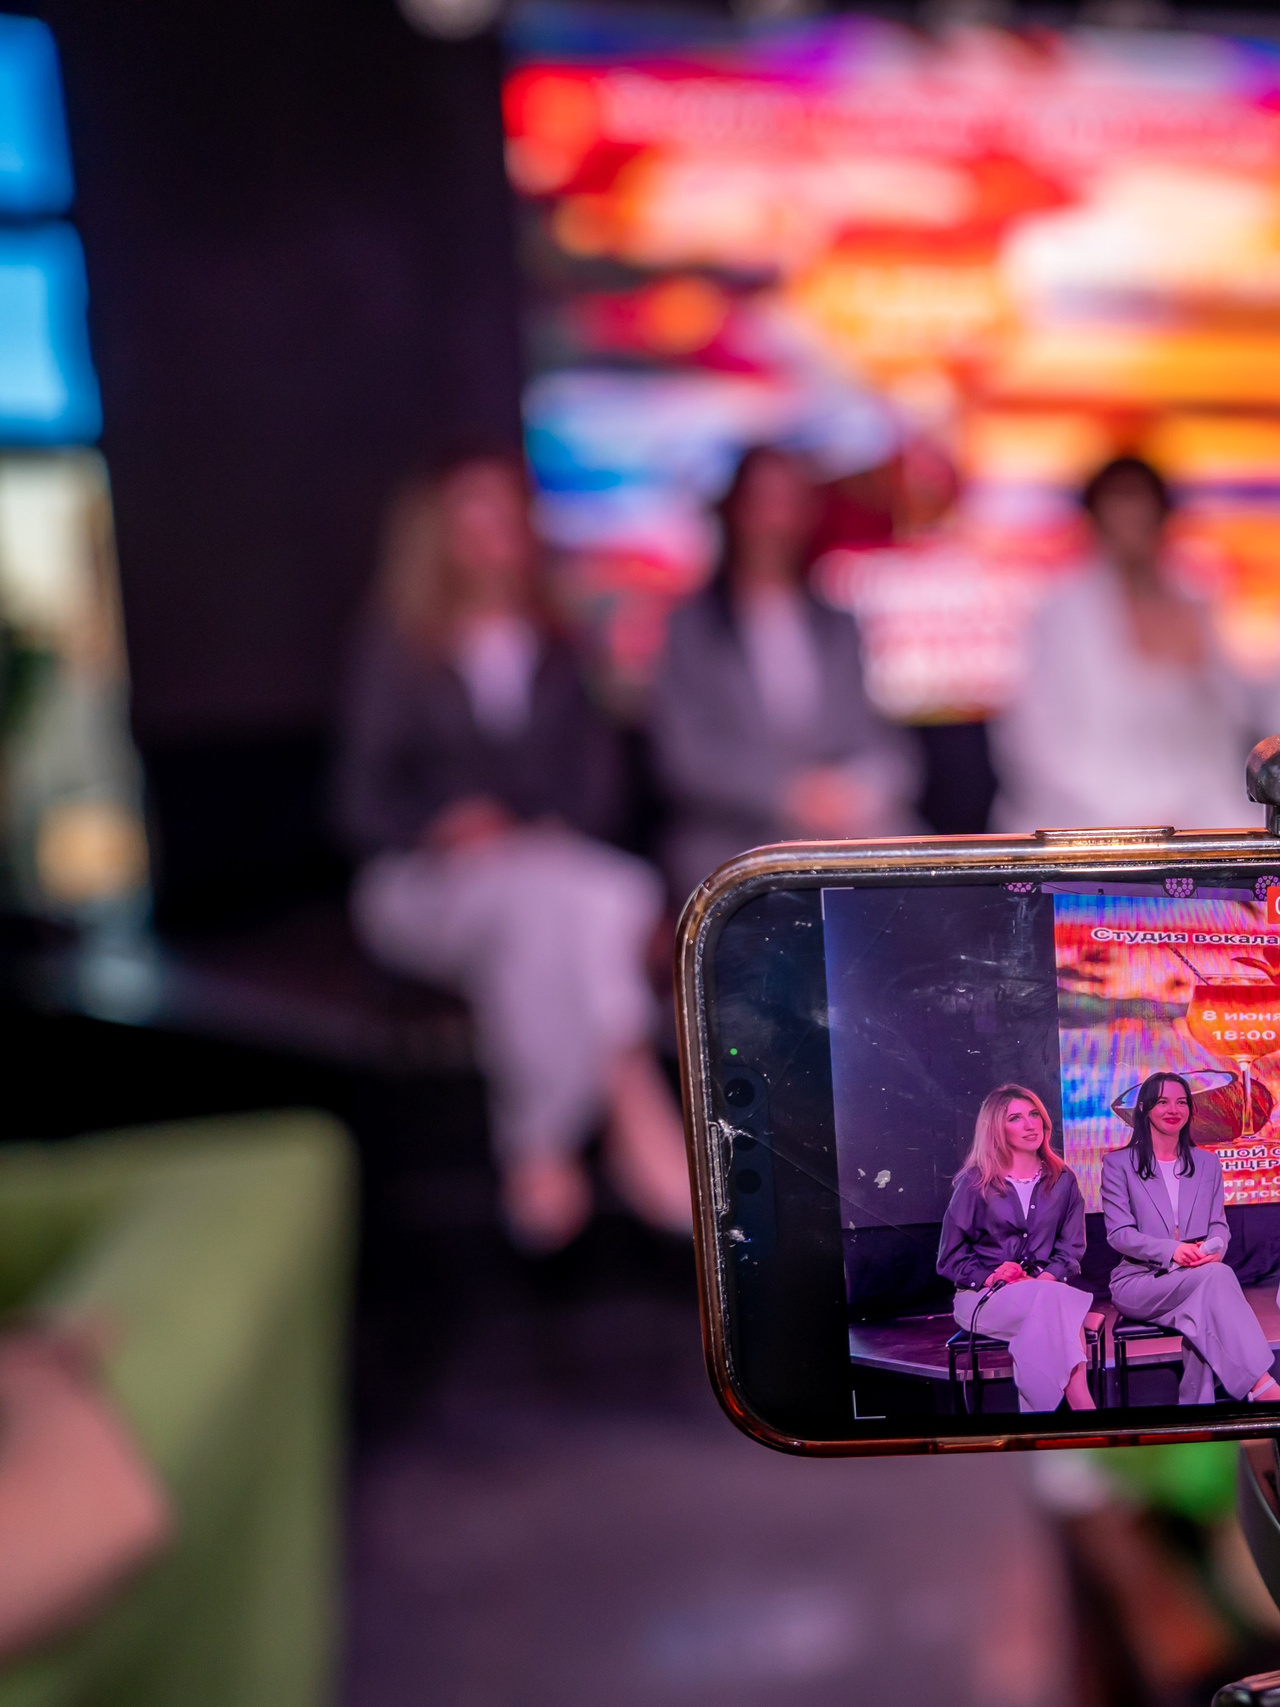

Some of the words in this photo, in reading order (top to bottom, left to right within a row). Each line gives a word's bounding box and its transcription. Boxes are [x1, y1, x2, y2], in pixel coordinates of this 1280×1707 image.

[1091, 927, 1188, 944] Студия
[1192, 933, 1280, 945] вокала
[1202, 1010, 1218, 1022] 8
[1211, 1030, 1277, 1041] 18:00
